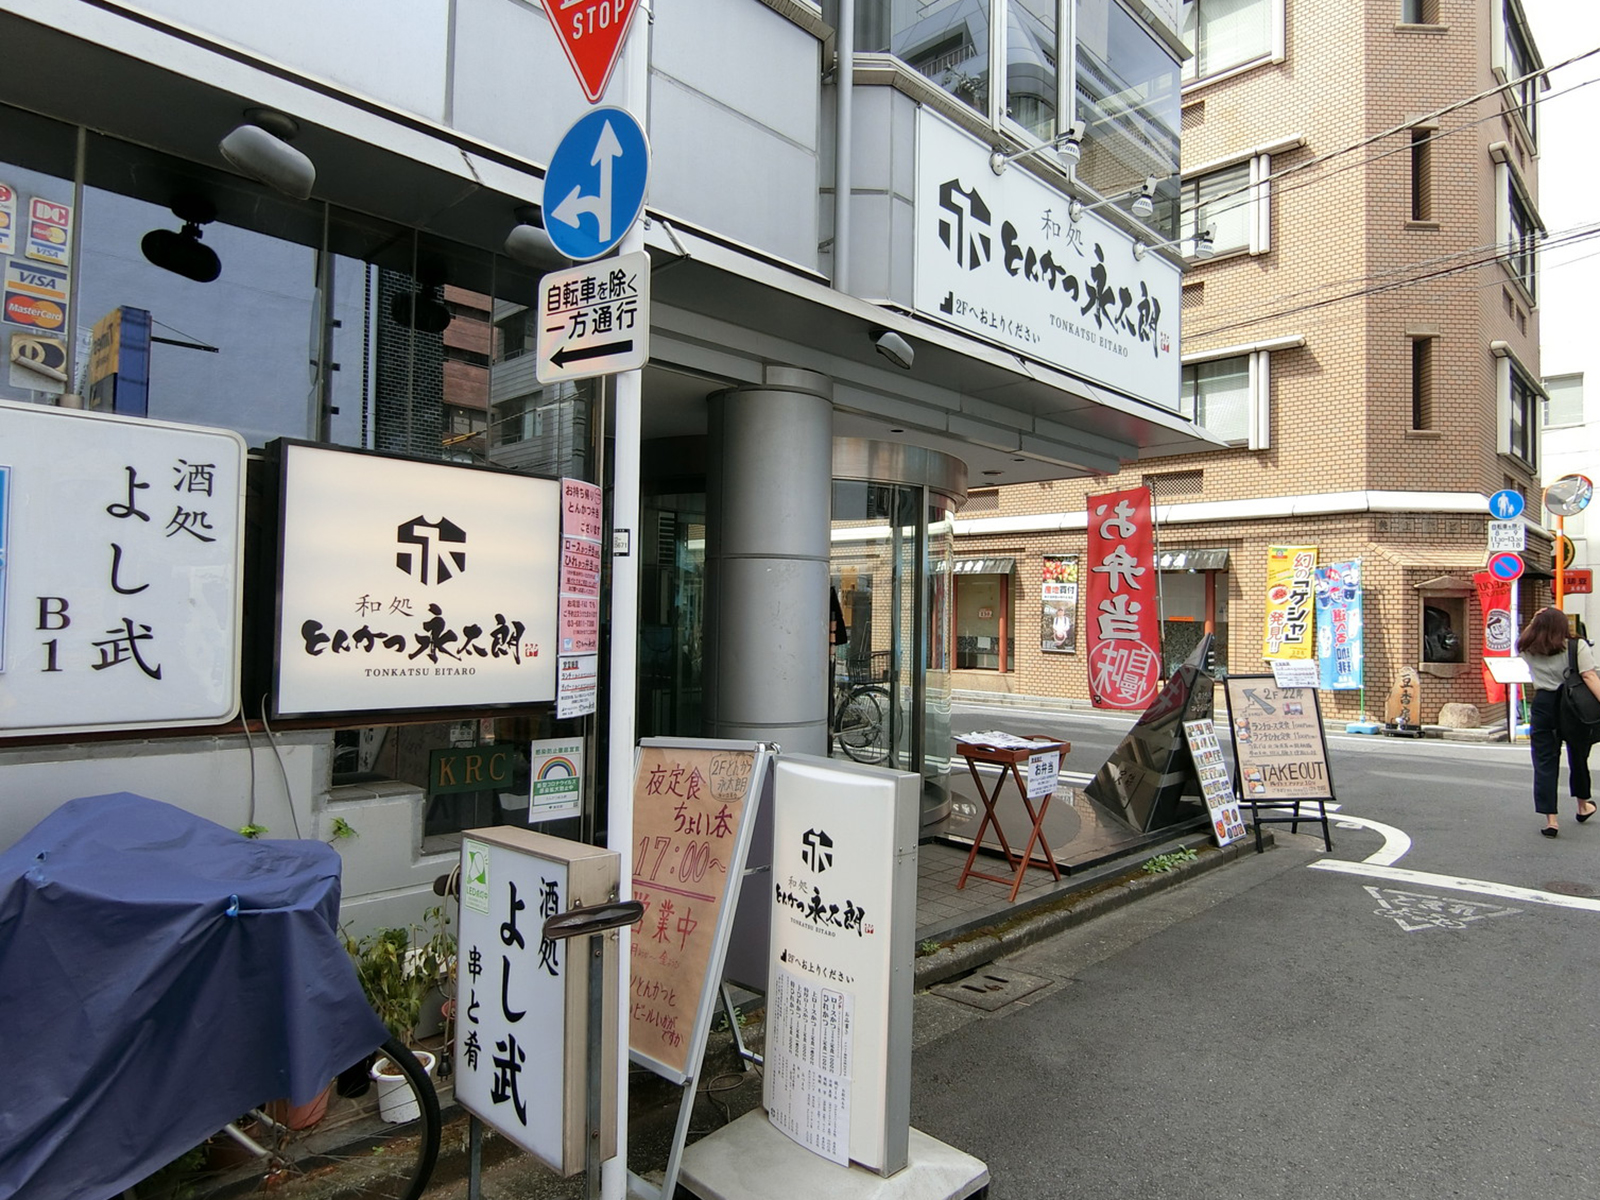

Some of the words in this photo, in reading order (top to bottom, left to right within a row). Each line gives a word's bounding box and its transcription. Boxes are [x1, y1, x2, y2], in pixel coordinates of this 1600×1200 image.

[572, 0, 625, 39] STOP
[1041, 208, 1084, 257] 和処
[20, 271, 57, 289] VISA
[547, 268, 638, 312] 自転車を除く
[8, 303, 62, 321] MasterCard
[546, 300, 638, 339] 一方通行
[955, 298, 1041, 344] 2Fへお上りください
[1050, 313, 1096, 344] TONKATSU
[1099, 335, 1129, 358] EITARO
[166, 458, 217, 542] 酒処
[91, 465, 162, 681] よし武
[355, 594, 414, 617] 和処
[364, 667, 430, 677] TONKATSU
[434, 667, 477, 677] EITARO
[645, 763, 706, 800] 夜定食
[674, 801, 733, 838] ちょい呑
[788, 876, 809, 894] 和処
[787, 953, 855, 983] 2Fへお上りください
[463, 945, 483, 1072] 串と肴
[491, 881, 527, 1126] よし武
